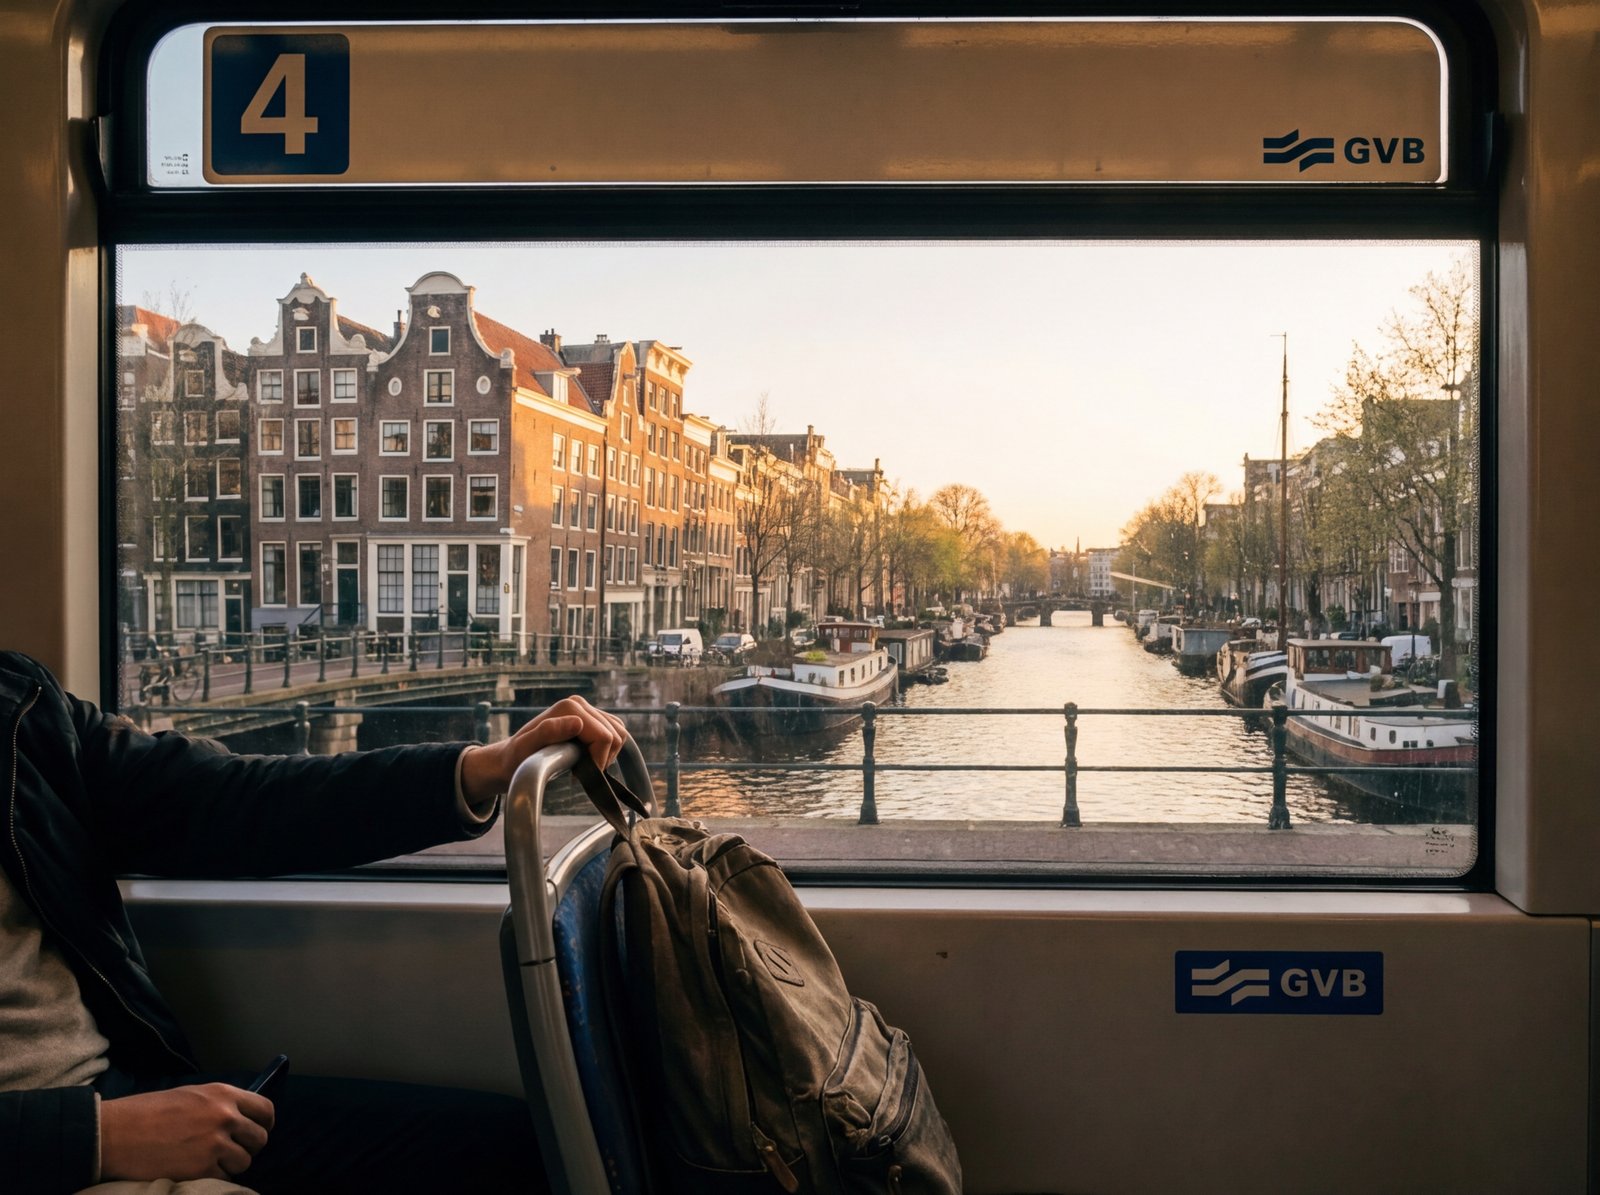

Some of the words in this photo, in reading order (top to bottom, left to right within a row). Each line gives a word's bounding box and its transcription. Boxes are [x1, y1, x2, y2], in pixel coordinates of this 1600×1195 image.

[240, 53, 318, 155] 4
[1344, 137, 1425, 164] GVB
[1280, 968, 1367, 998] GVB
